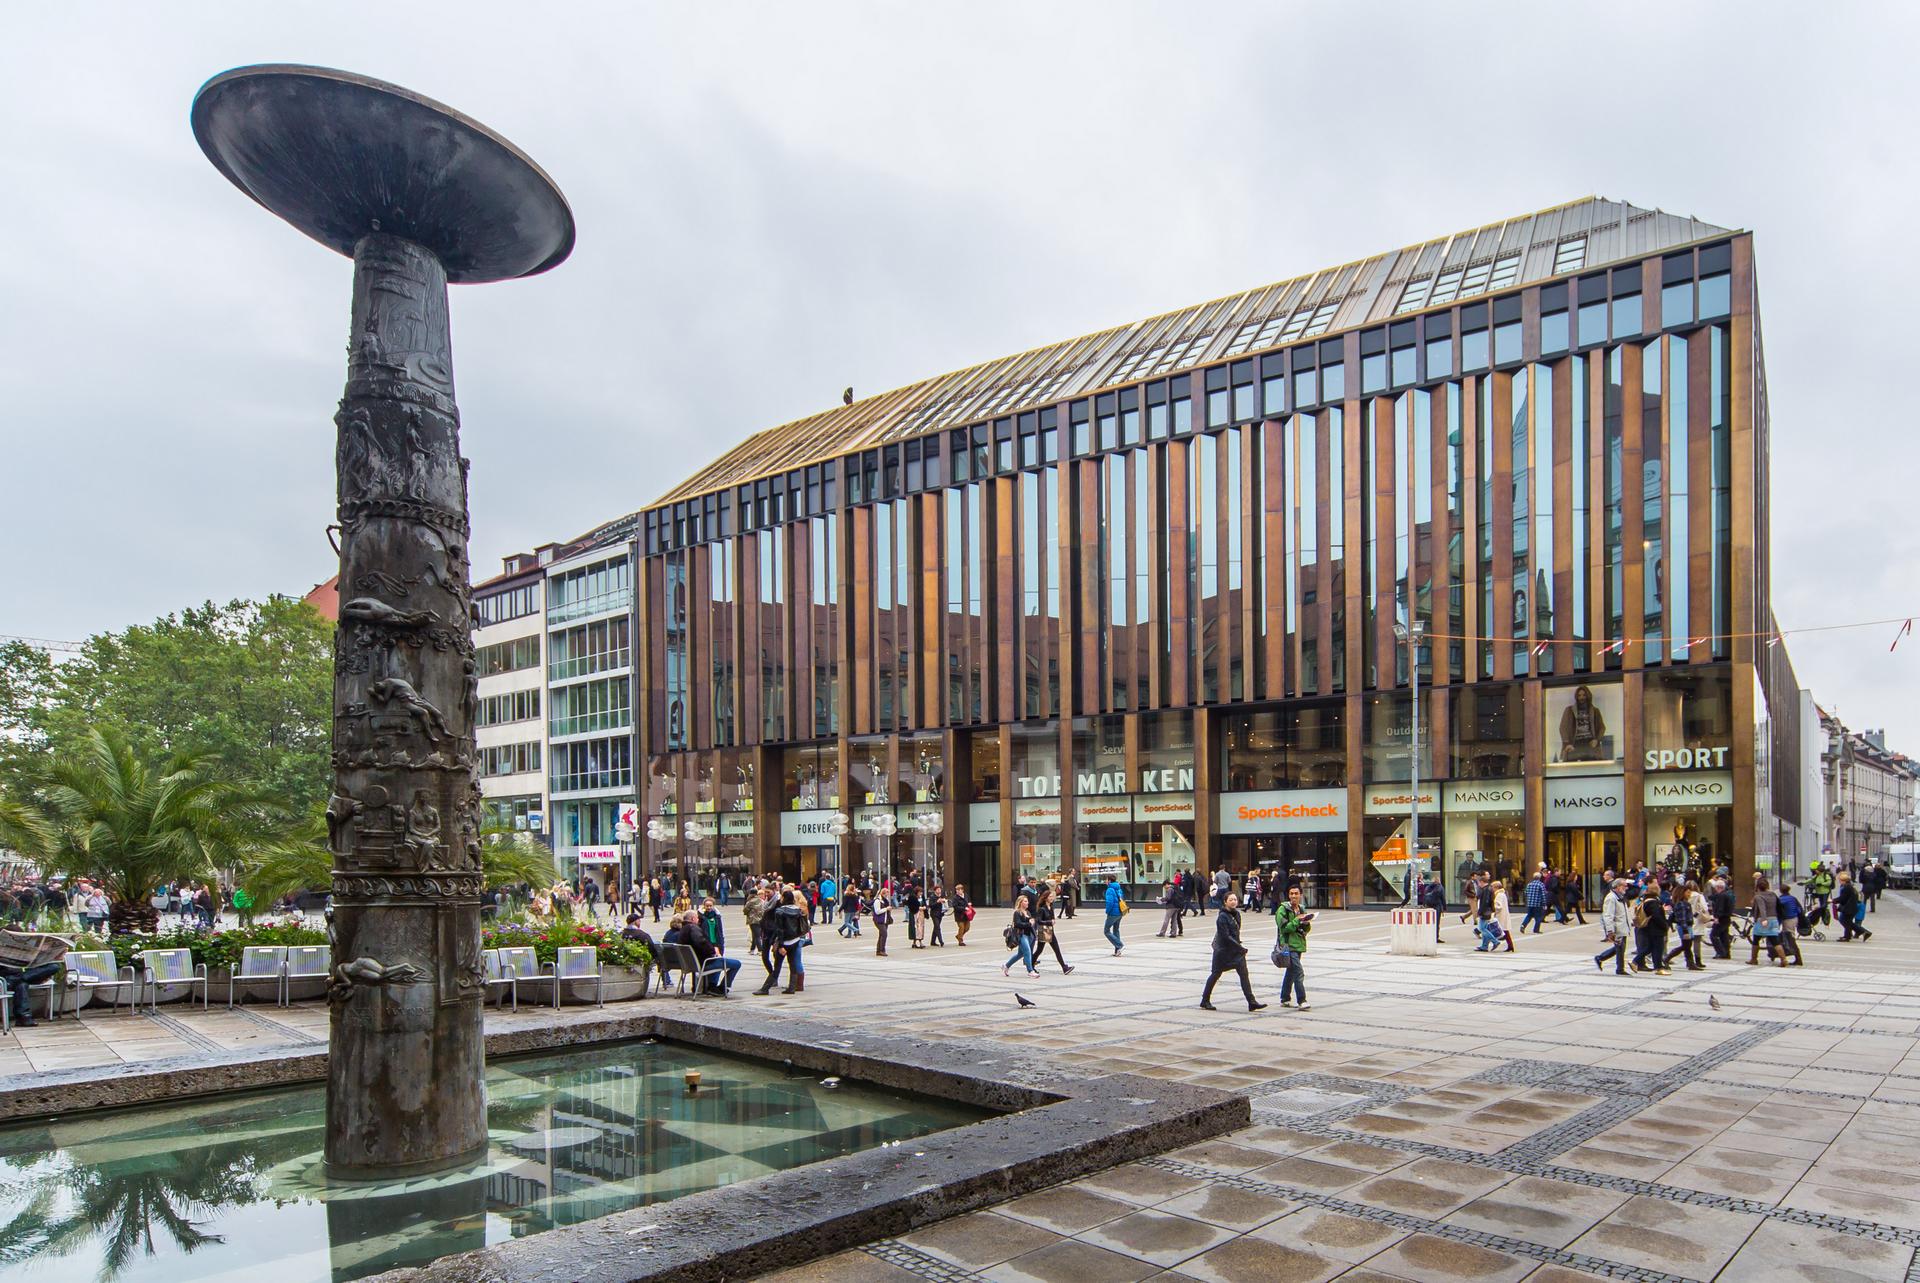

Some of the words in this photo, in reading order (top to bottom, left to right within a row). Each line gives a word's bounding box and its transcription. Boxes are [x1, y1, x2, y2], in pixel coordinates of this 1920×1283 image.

[1386, 727, 1428, 736] Outdor
[1645, 747, 1729, 770] SPORT
[1654, 782, 1723, 796] MANGO
[1454, 790, 1514, 803] MANGO
[1554, 796, 1617, 809] MANGO
[1082, 805, 1129, 816] SportScheck
[1144, 803, 1192, 813] SportScheck
[1238, 803, 1339, 821] SportScheck
[580, 851, 596, 859] TALLY
